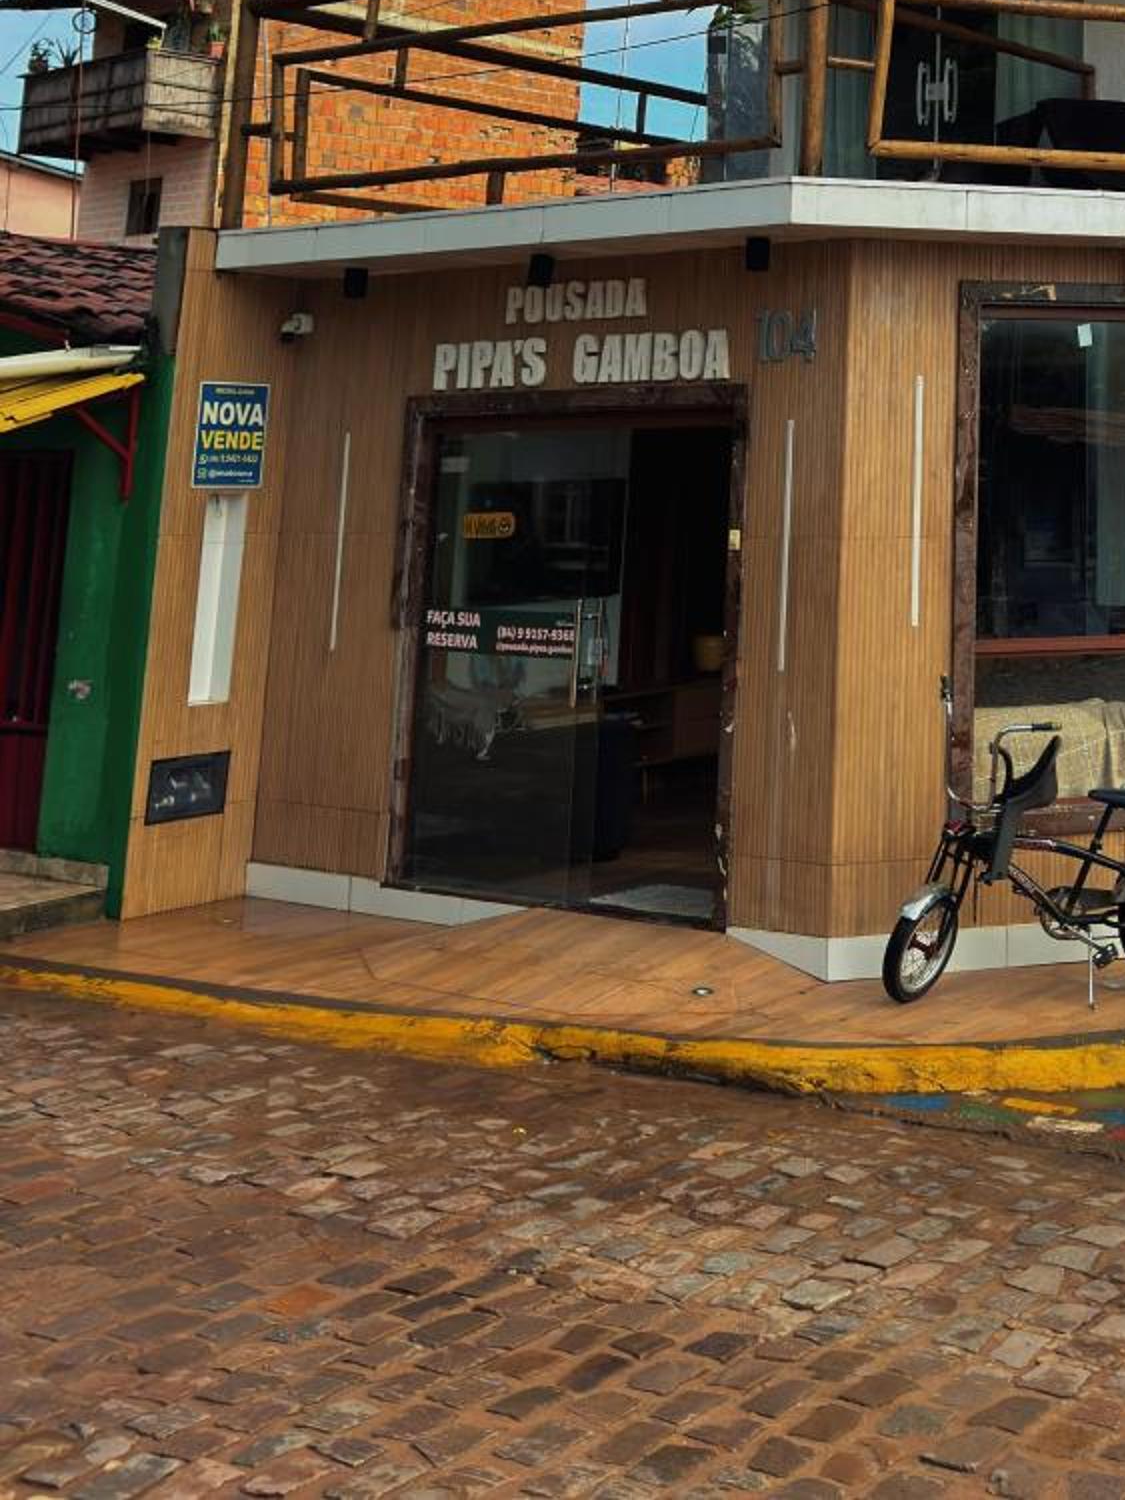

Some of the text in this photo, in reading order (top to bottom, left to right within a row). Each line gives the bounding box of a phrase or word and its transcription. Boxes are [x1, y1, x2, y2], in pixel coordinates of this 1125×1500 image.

[505, 278, 647, 324] POUSADA
[757, 308, 816, 361] 104
[433, 330, 730, 390] PIPA'S GAMBOA
[202, 401, 264, 426] NOVA
[201, 431, 263, 450] VENDE
[427, 610, 481, 628] FAÇA SUA
[427, 632, 478, 649] RESERVA
